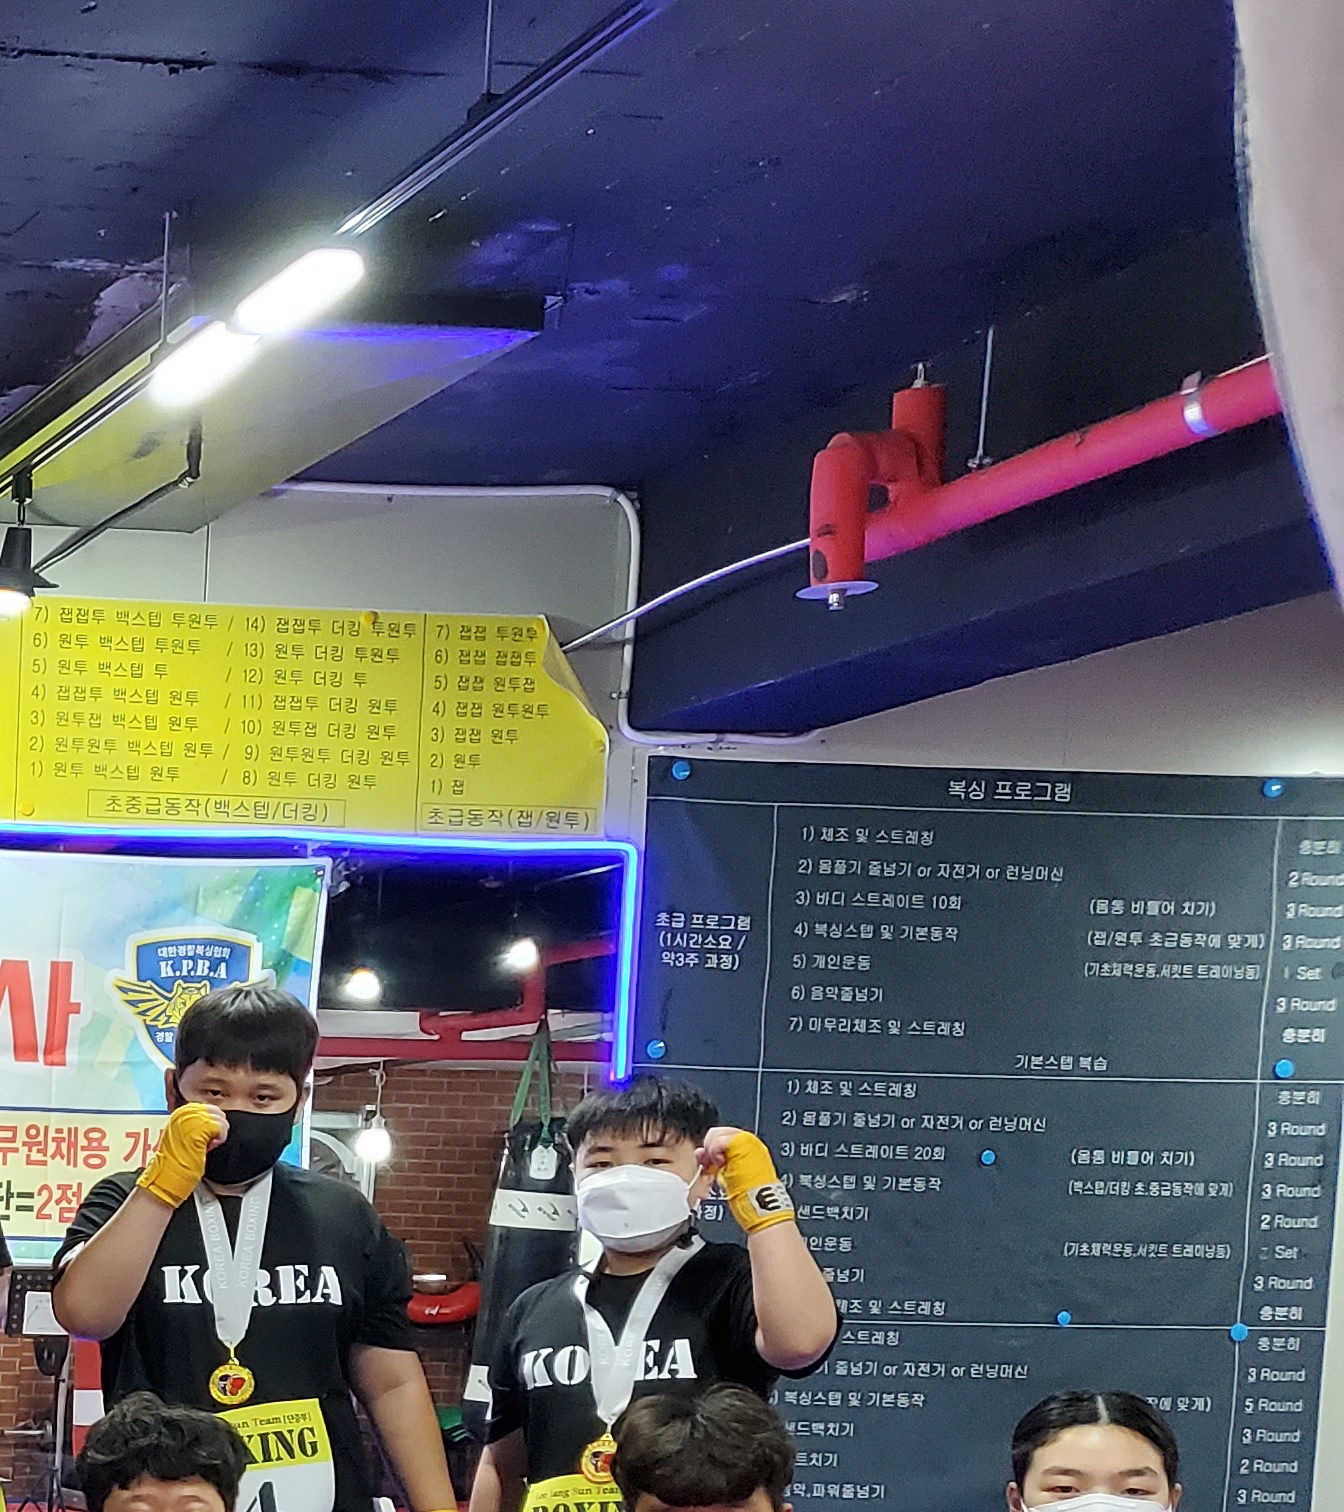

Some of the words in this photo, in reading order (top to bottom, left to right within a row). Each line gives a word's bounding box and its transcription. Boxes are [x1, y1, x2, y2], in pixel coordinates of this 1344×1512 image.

[948, 780, 985, 799] 복싱
[994, 781, 1072, 802] 프로그램
[105, 793, 329, 824] 초중급동작(백스텝/더킹)
[428, 808, 590, 830] 초급동작(잽/원투)
[802, 827, 814, 841] 1)
[875, 830, 934, 846] 스트레칭
[798, 860, 812, 875] 2)
[918, 866, 932, 877] or
[937, 864, 980, 880] 자전거
[986, 868, 1000, 879] or
[796, 891, 810, 906] 3)
[816, 891, 845, 906] 바디
[852, 893, 925, 909] 스트레이트
[932, 895, 962, 911] 10회
[691, 914, 751, 931] 프로그램
[794, 923, 808, 938] 4)
[159, 959, 228, 979] K.P.B.A
[793, 954, 806, 969] 5)
[523, 1338, 698, 1390] KOEA
